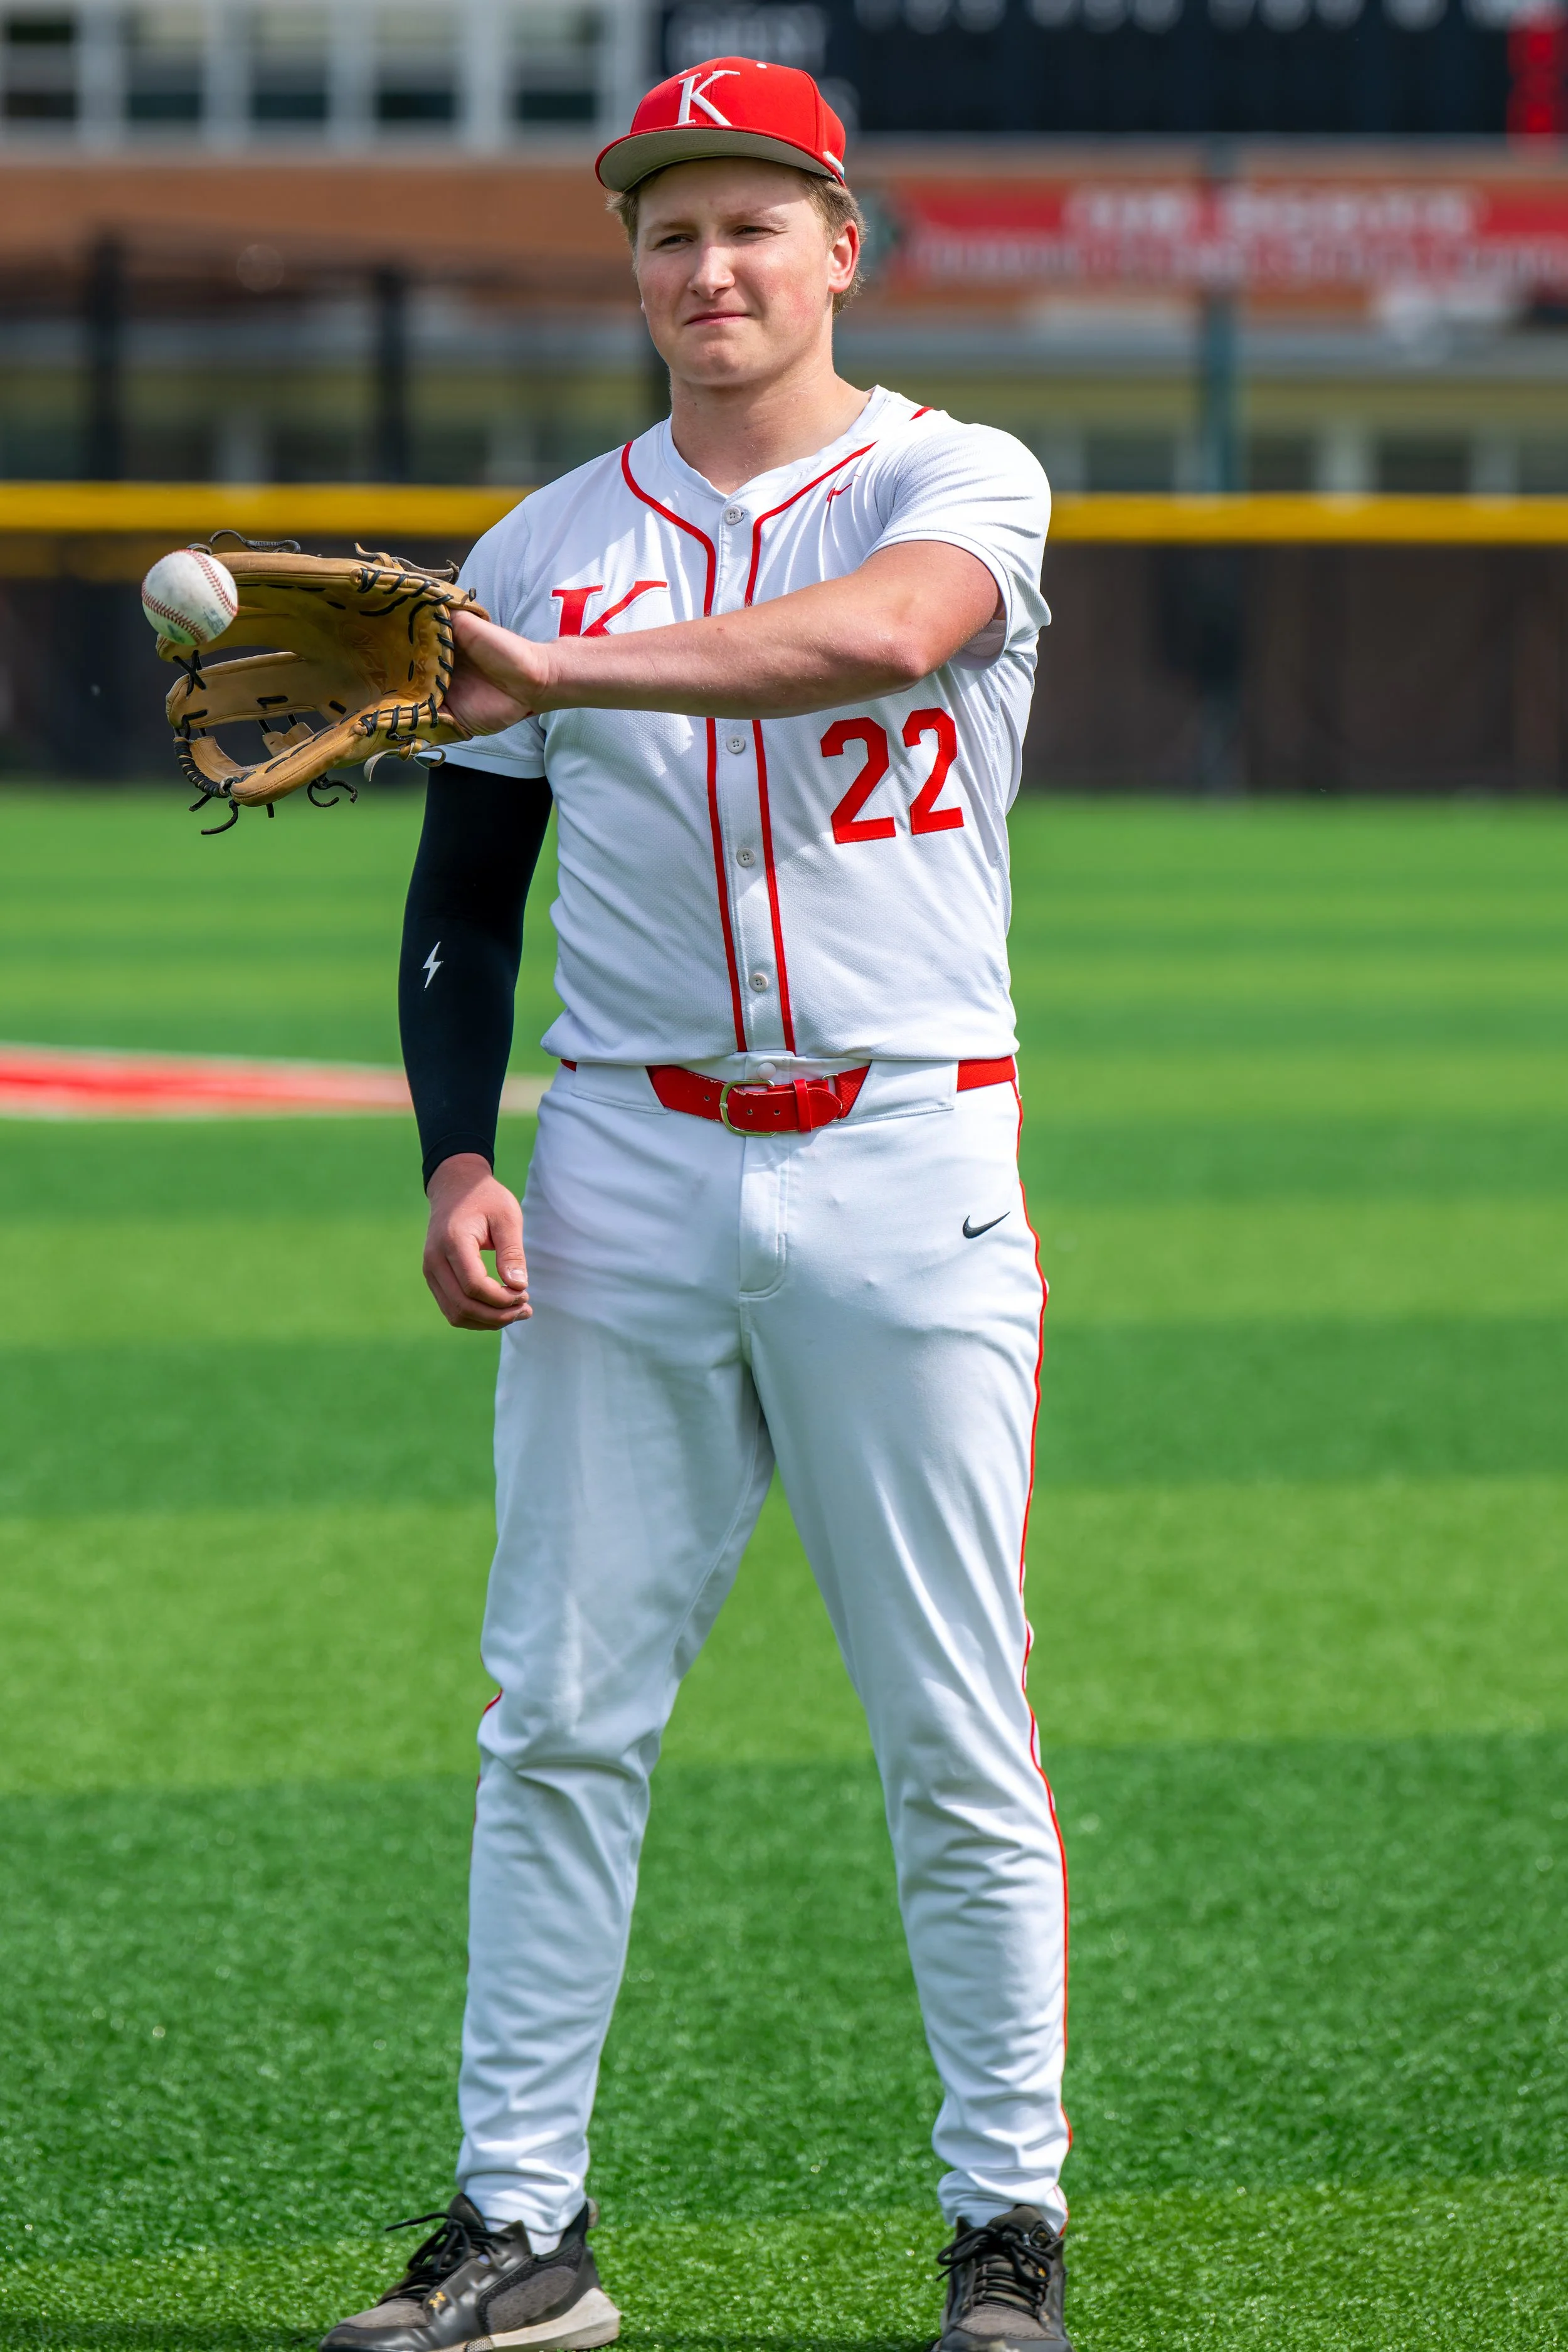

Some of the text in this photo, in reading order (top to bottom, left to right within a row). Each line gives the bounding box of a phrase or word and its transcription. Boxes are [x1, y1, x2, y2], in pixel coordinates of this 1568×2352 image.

[674, 69, 741, 126] K
[551, 580, 668, 638] K
[820, 707, 965, 844] 22
